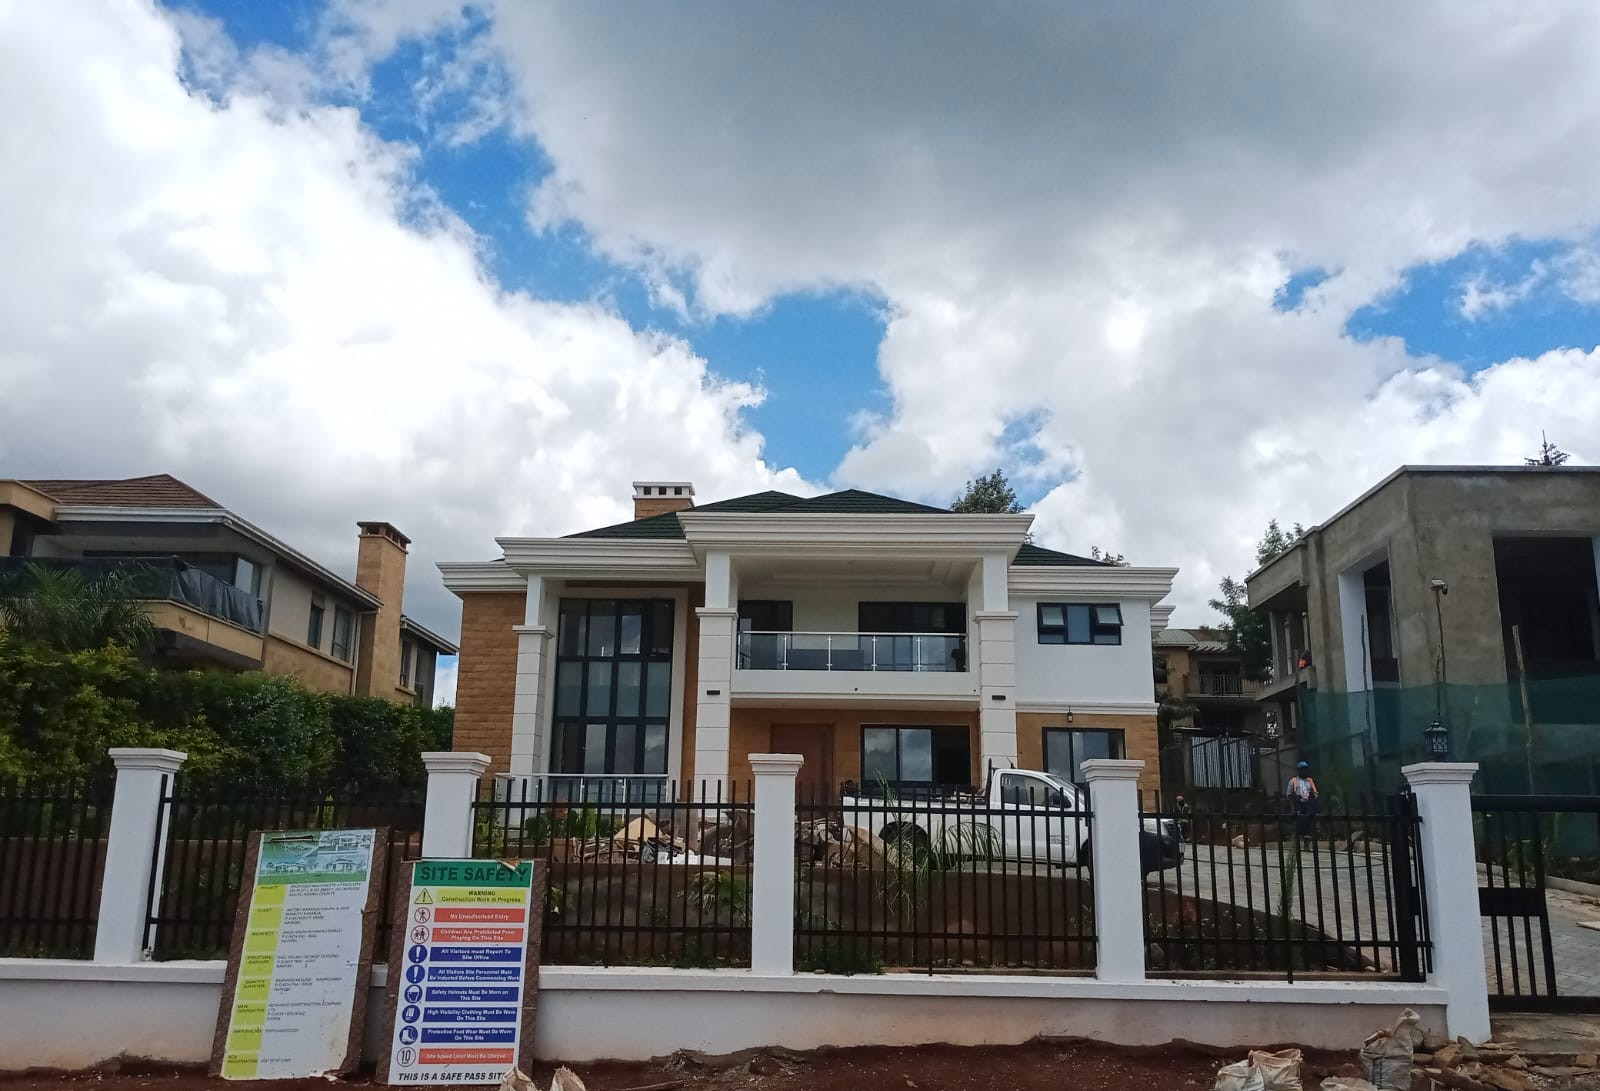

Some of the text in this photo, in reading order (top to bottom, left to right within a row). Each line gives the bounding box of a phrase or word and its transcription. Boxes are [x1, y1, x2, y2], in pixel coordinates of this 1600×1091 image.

[421, 866, 528, 881] SITE SAFETY
[402, 1050, 411, 1061] 10
